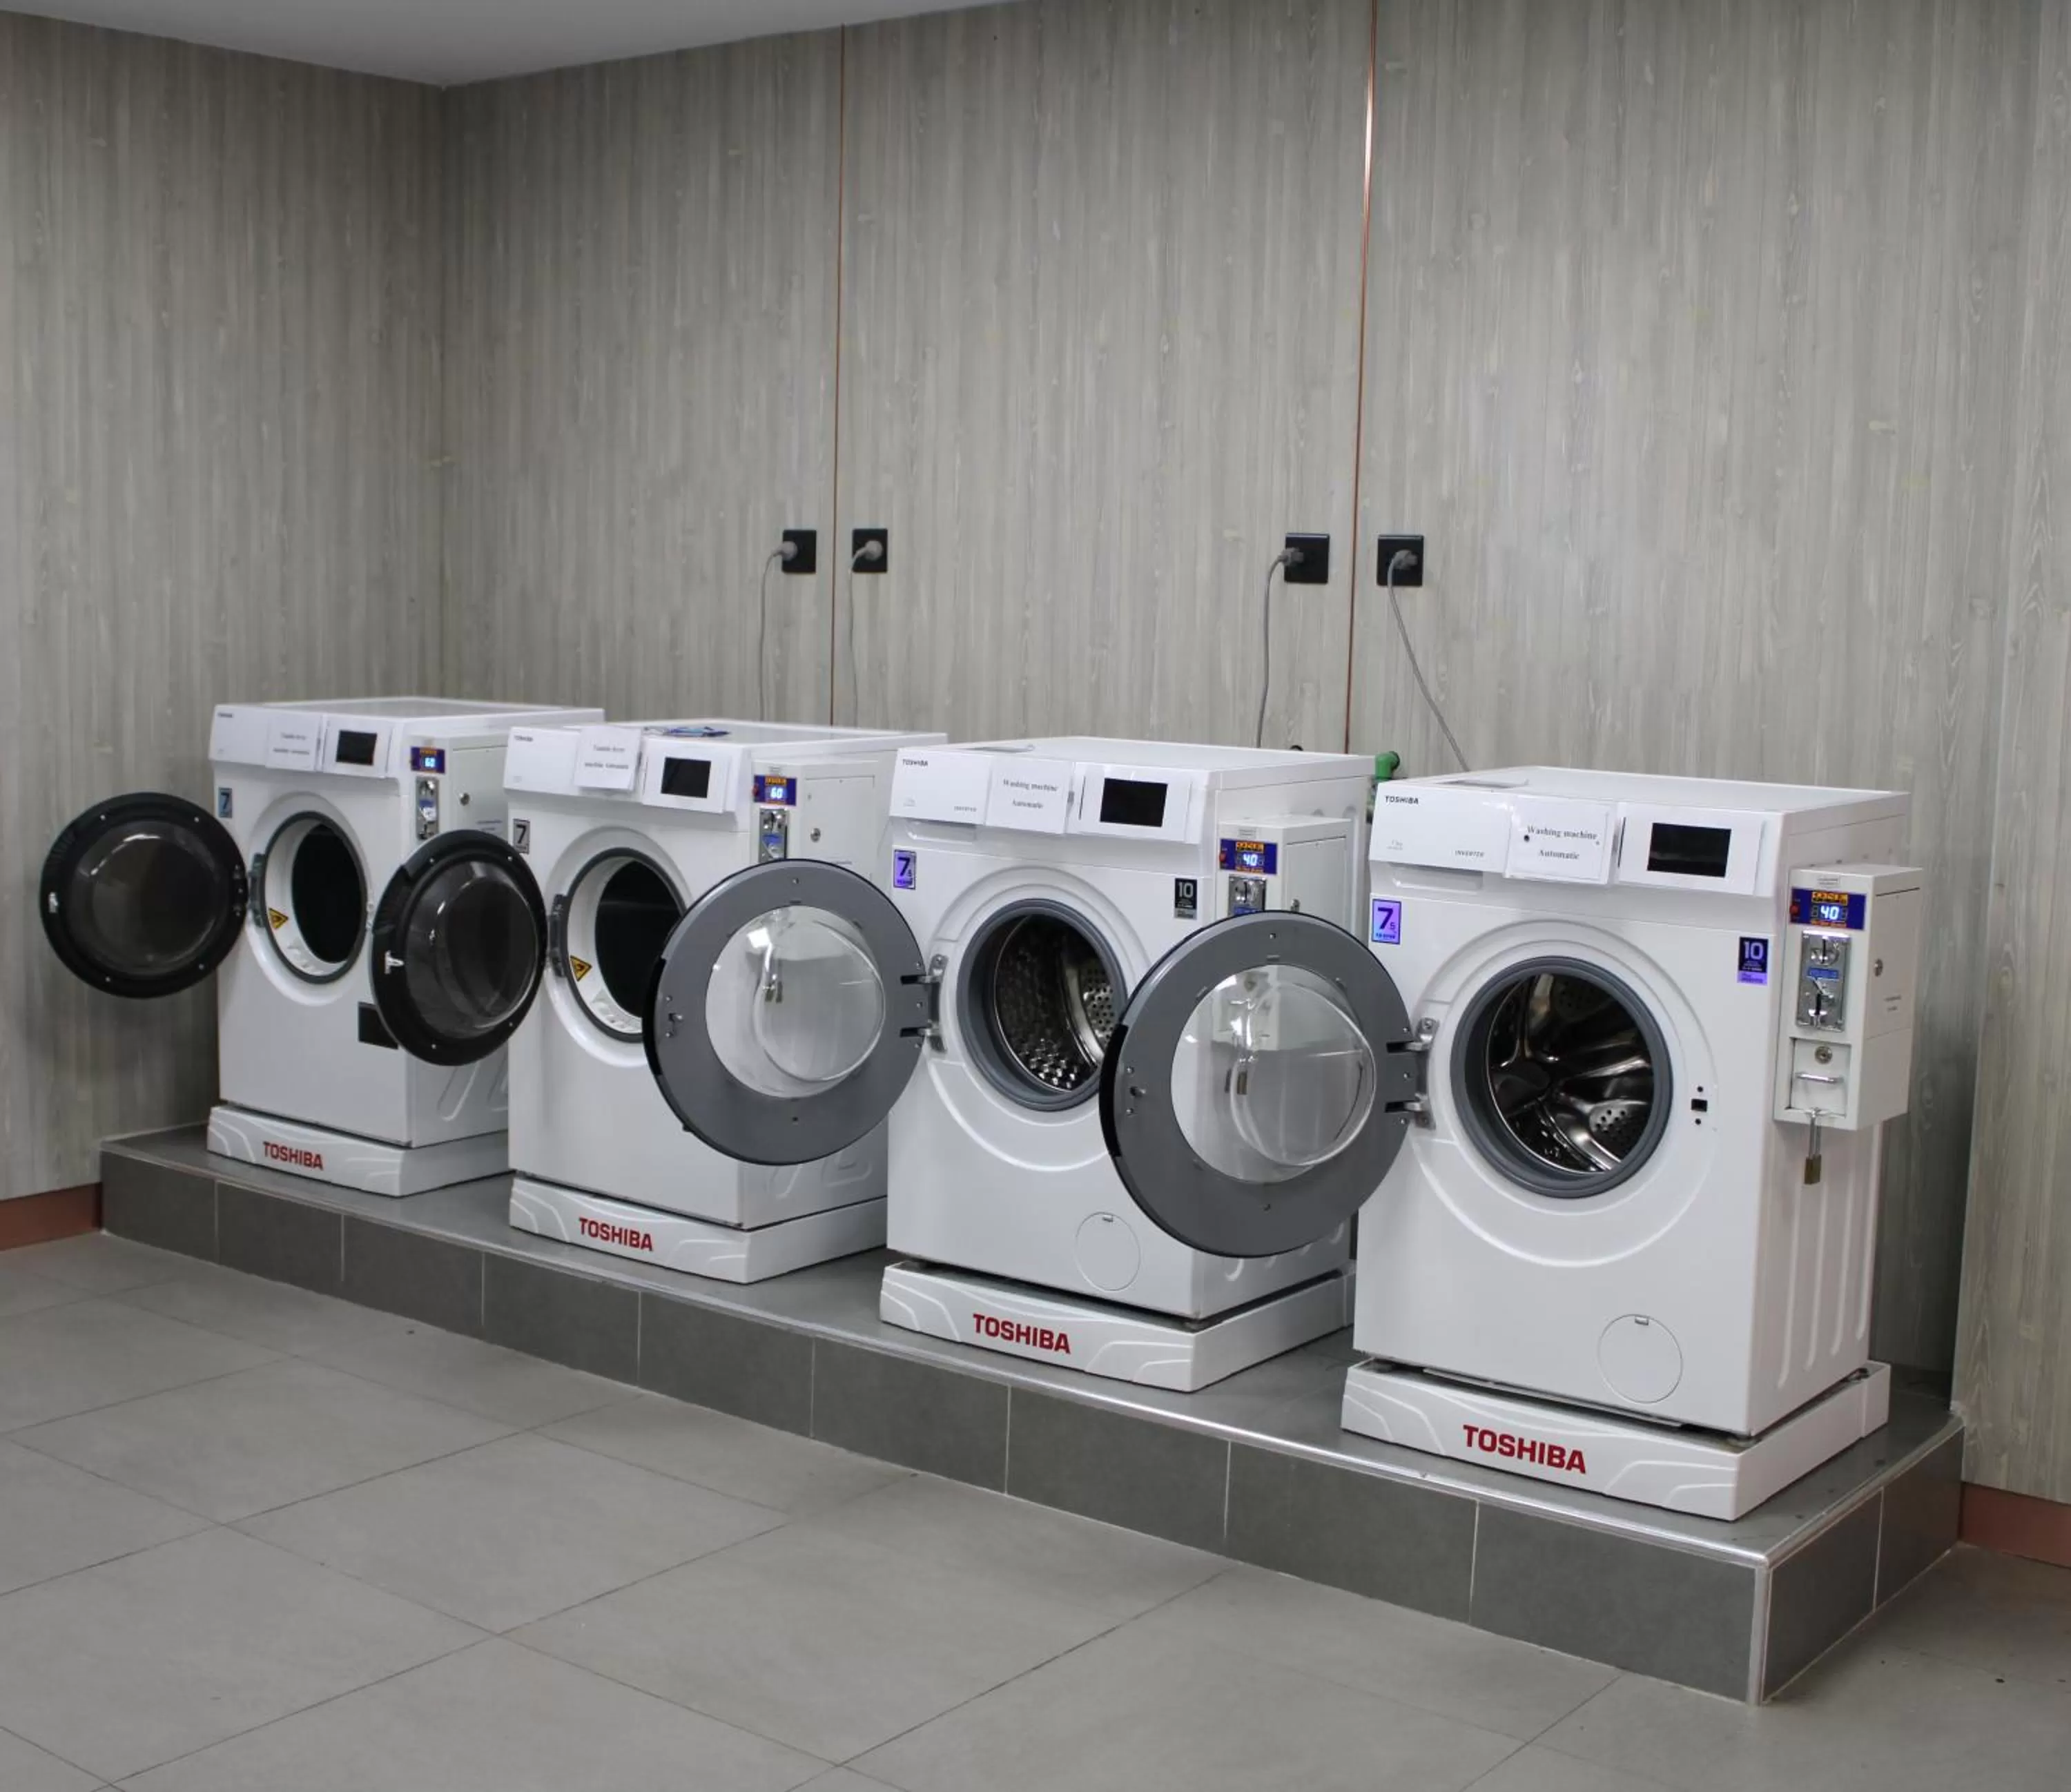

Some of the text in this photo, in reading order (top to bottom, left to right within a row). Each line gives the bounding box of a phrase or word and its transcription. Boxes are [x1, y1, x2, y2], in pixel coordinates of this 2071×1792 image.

[1385, 795, 1419, 805] TOSHIBA
[516, 824, 526, 844] 7
[1527, 826, 1597, 840] Washing machine
[1243, 853, 1258, 867] 40
[1538, 849, 1580, 859] Automatic
[1178, 882, 1194, 898] 10
[1820, 905, 1840, 920] 40
[1744, 941, 1764, 960] 10
[263, 1141, 324, 1171] TOSHIBA
[578, 1217, 653, 1252] TOSHIBA
[973, 1312, 1071, 1355] TOSHIBA
[1463, 1424, 1586, 1474] TOSHIBA
